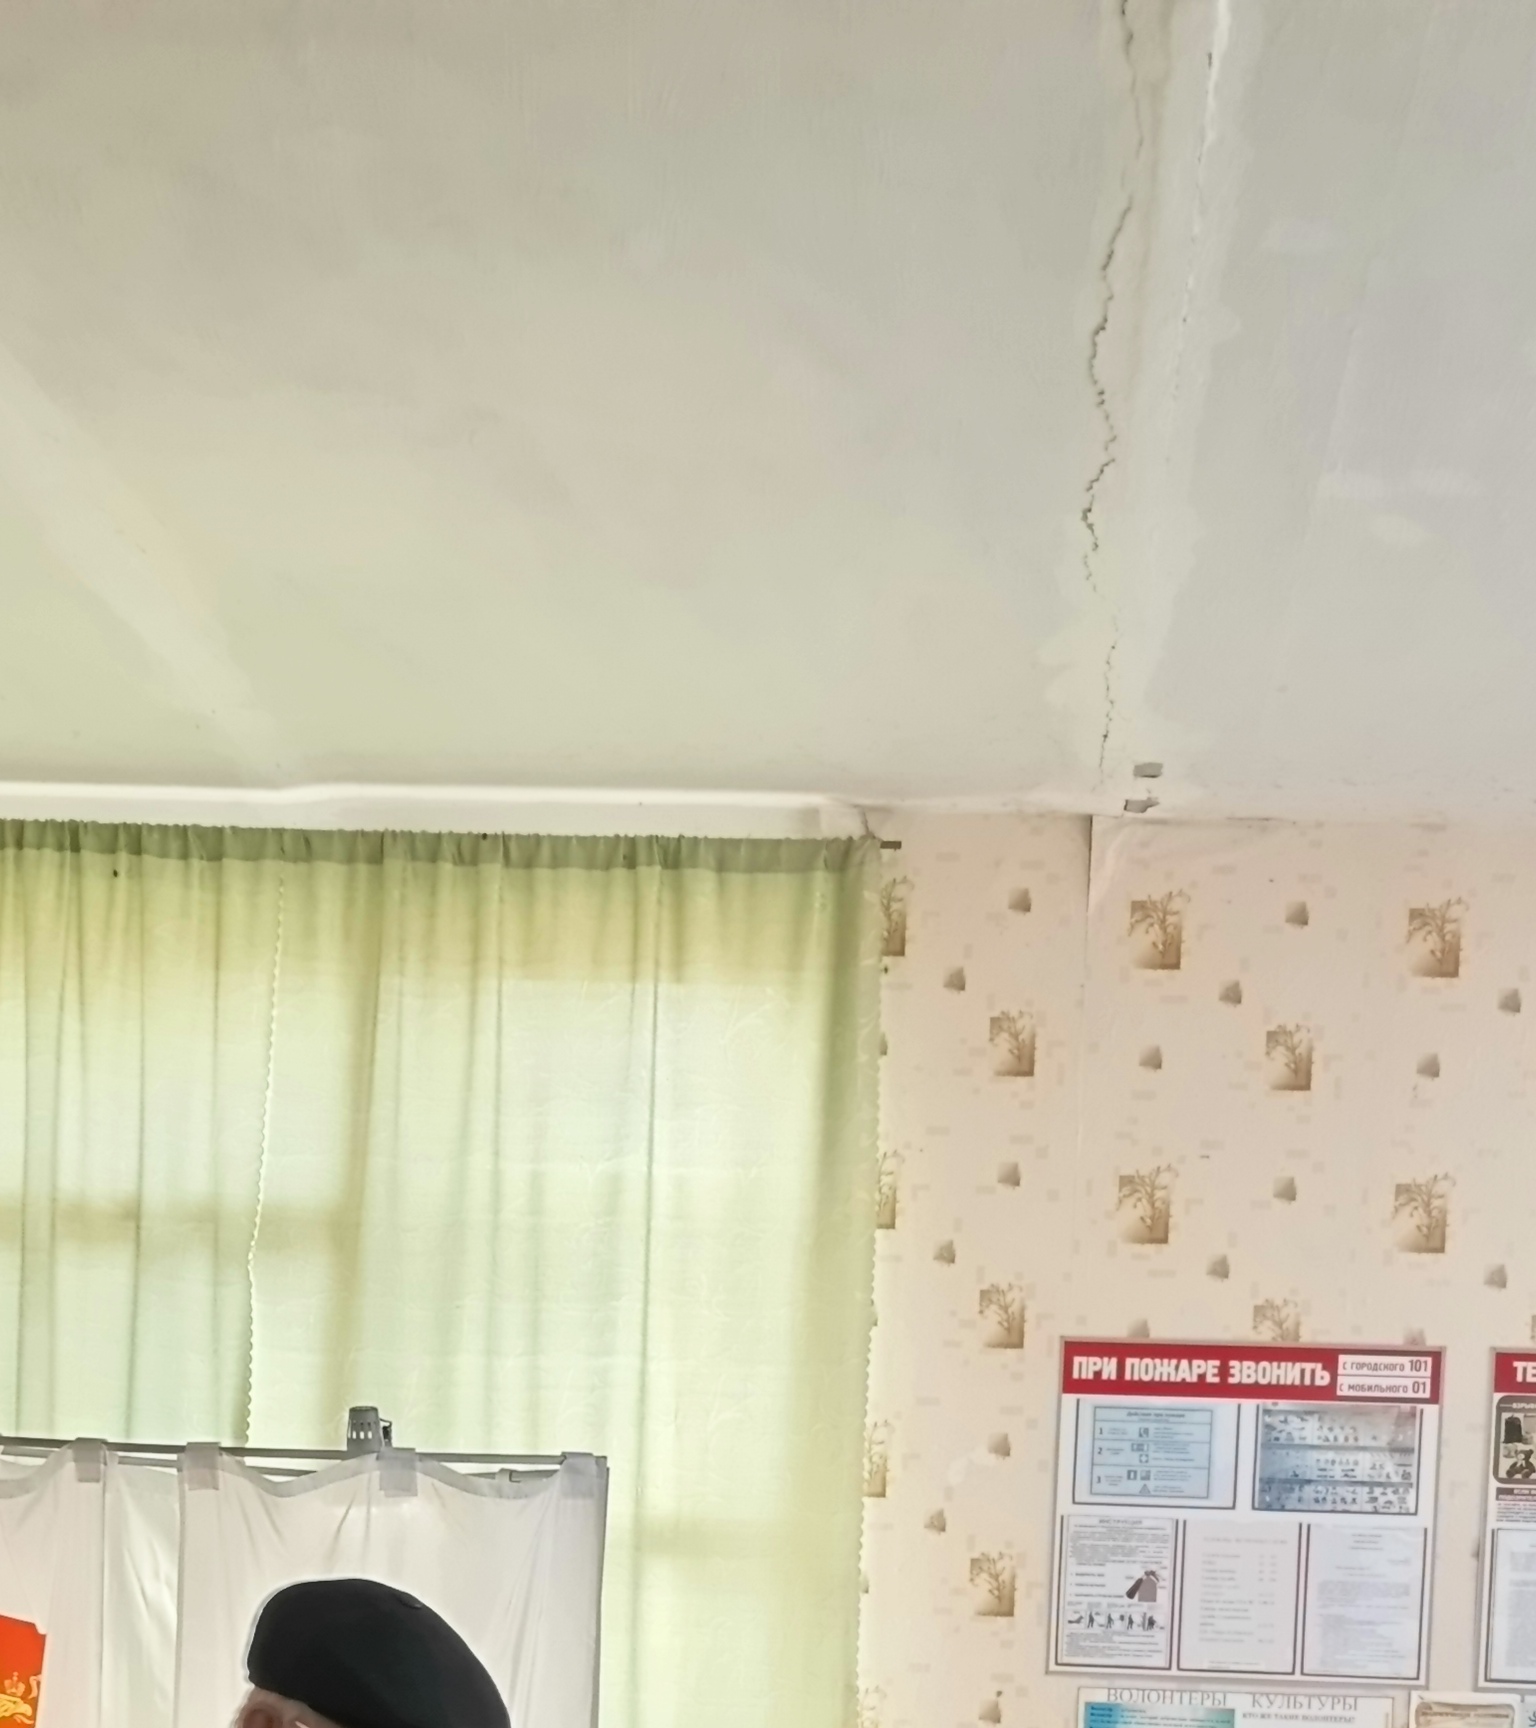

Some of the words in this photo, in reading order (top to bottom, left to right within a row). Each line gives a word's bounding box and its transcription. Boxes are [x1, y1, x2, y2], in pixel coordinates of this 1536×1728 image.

[1072, 1355, 1117, 1381] ПРИ
[1125, 1357, 1221, 1384] ПОЖАРЕ
[1226, 1359, 1332, 1386] ЗВОНИТЬ
[1350, 1361, 1406, 1373] ГОРОДСКОГО
[1408, 1359, 1429, 1373] 101
[1347, 1383, 1409, 1394] МОБИЛЬНОГО
[1411, 1381, 1428, 1394] 01
[1106, 1687, 1227, 1707] ВОЛОНТЕРЫ
[1250, 1692, 1358, 1711] КУЛЬТУРЫ
